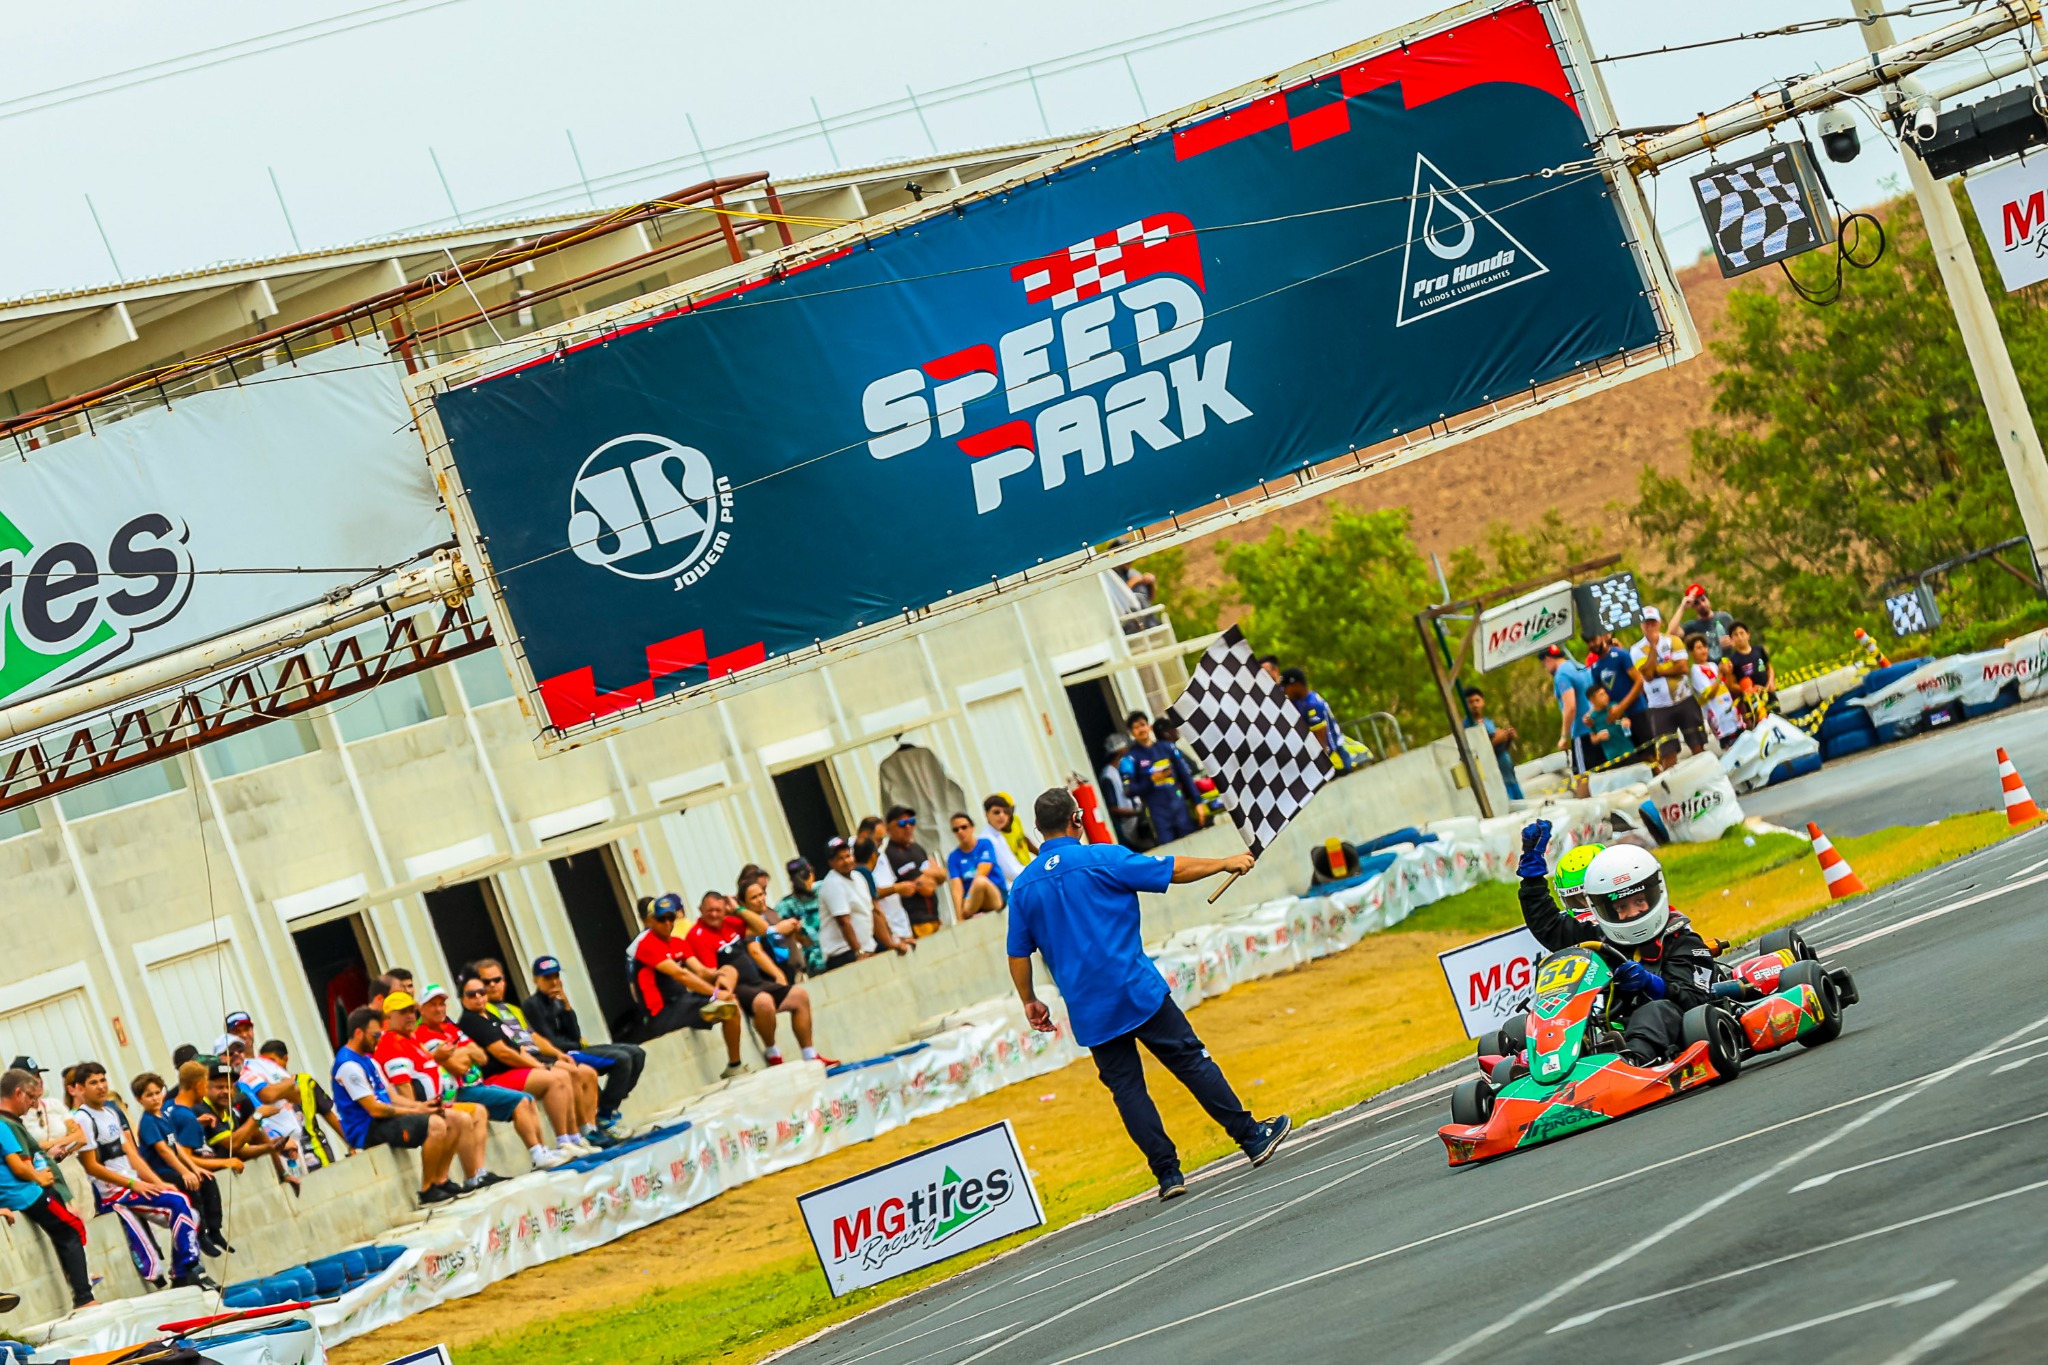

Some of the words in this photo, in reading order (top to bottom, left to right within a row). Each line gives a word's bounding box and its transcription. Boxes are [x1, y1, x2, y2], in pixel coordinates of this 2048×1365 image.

[1413, 274, 1449, 299] Pro
[1452, 249, 1516, 284] Honda
[1419, 291, 1451, 308] FLUIDOS
[1457, 269, 1511, 294] LUBRIFICANTES
[862, 277, 1205, 460] SPEED
[956, 341, 1254, 515] PARK
[715, 475, 735, 523] PAN
[1488, 608, 1568, 653] MGtires
[1540, 959, 1576, 987] 54
[1551, 1018, 1572, 1027] NET
[1540, 1108, 1605, 1132] ZINGALI
[833, 1168, 1012, 1259] MGtires
[862, 1218, 937, 1268] Racing
